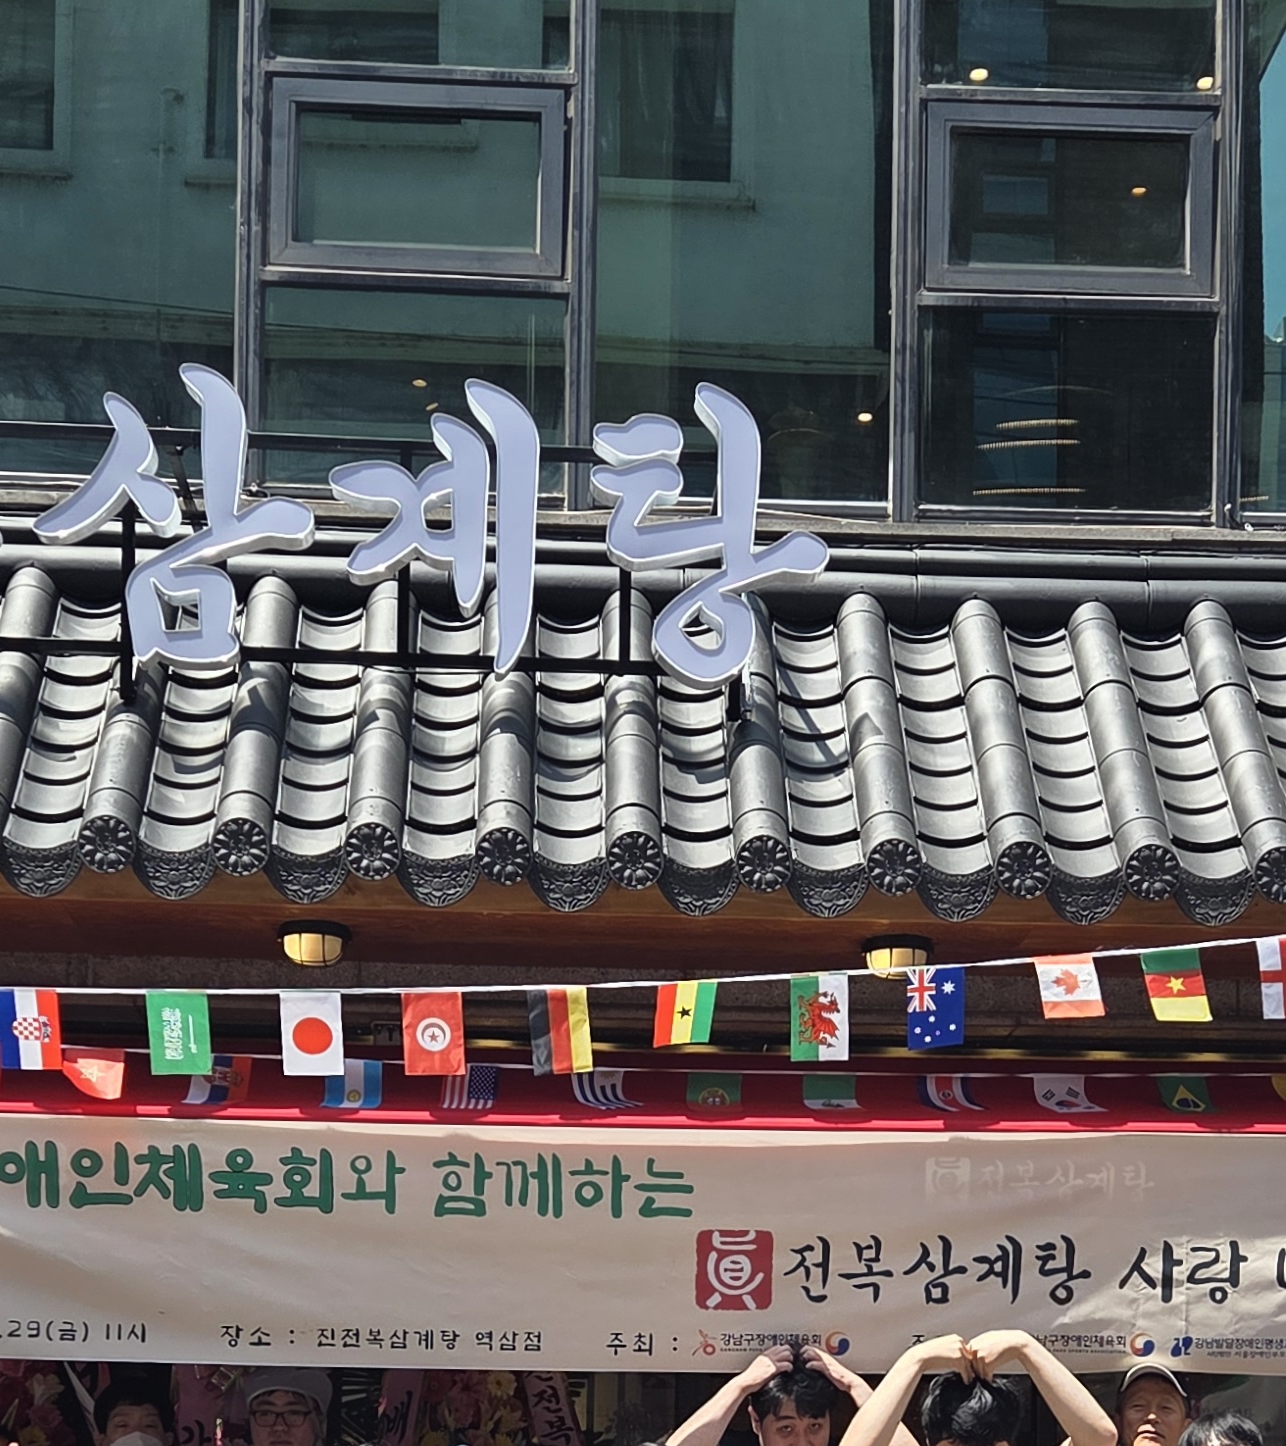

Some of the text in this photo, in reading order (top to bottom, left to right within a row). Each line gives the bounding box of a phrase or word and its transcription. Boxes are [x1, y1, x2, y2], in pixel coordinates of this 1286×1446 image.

[432, 1150, 695, 1220] 함께하는
[782, 1232, 1092, 1306] 전복삼계탕
[1118, 1237, 1249, 1306] 사랑
[104, 1319, 148, 1345] 11시
[219, 1324, 272, 1349] 장소
[315, 1326, 461, 1351] 진전복삼계탕
[474, 1328, 544, 1354] 역삼점
[605, 1330, 656, 1357] 주최
[1034, 1334, 1127, 1349] 남구장애인체육회
